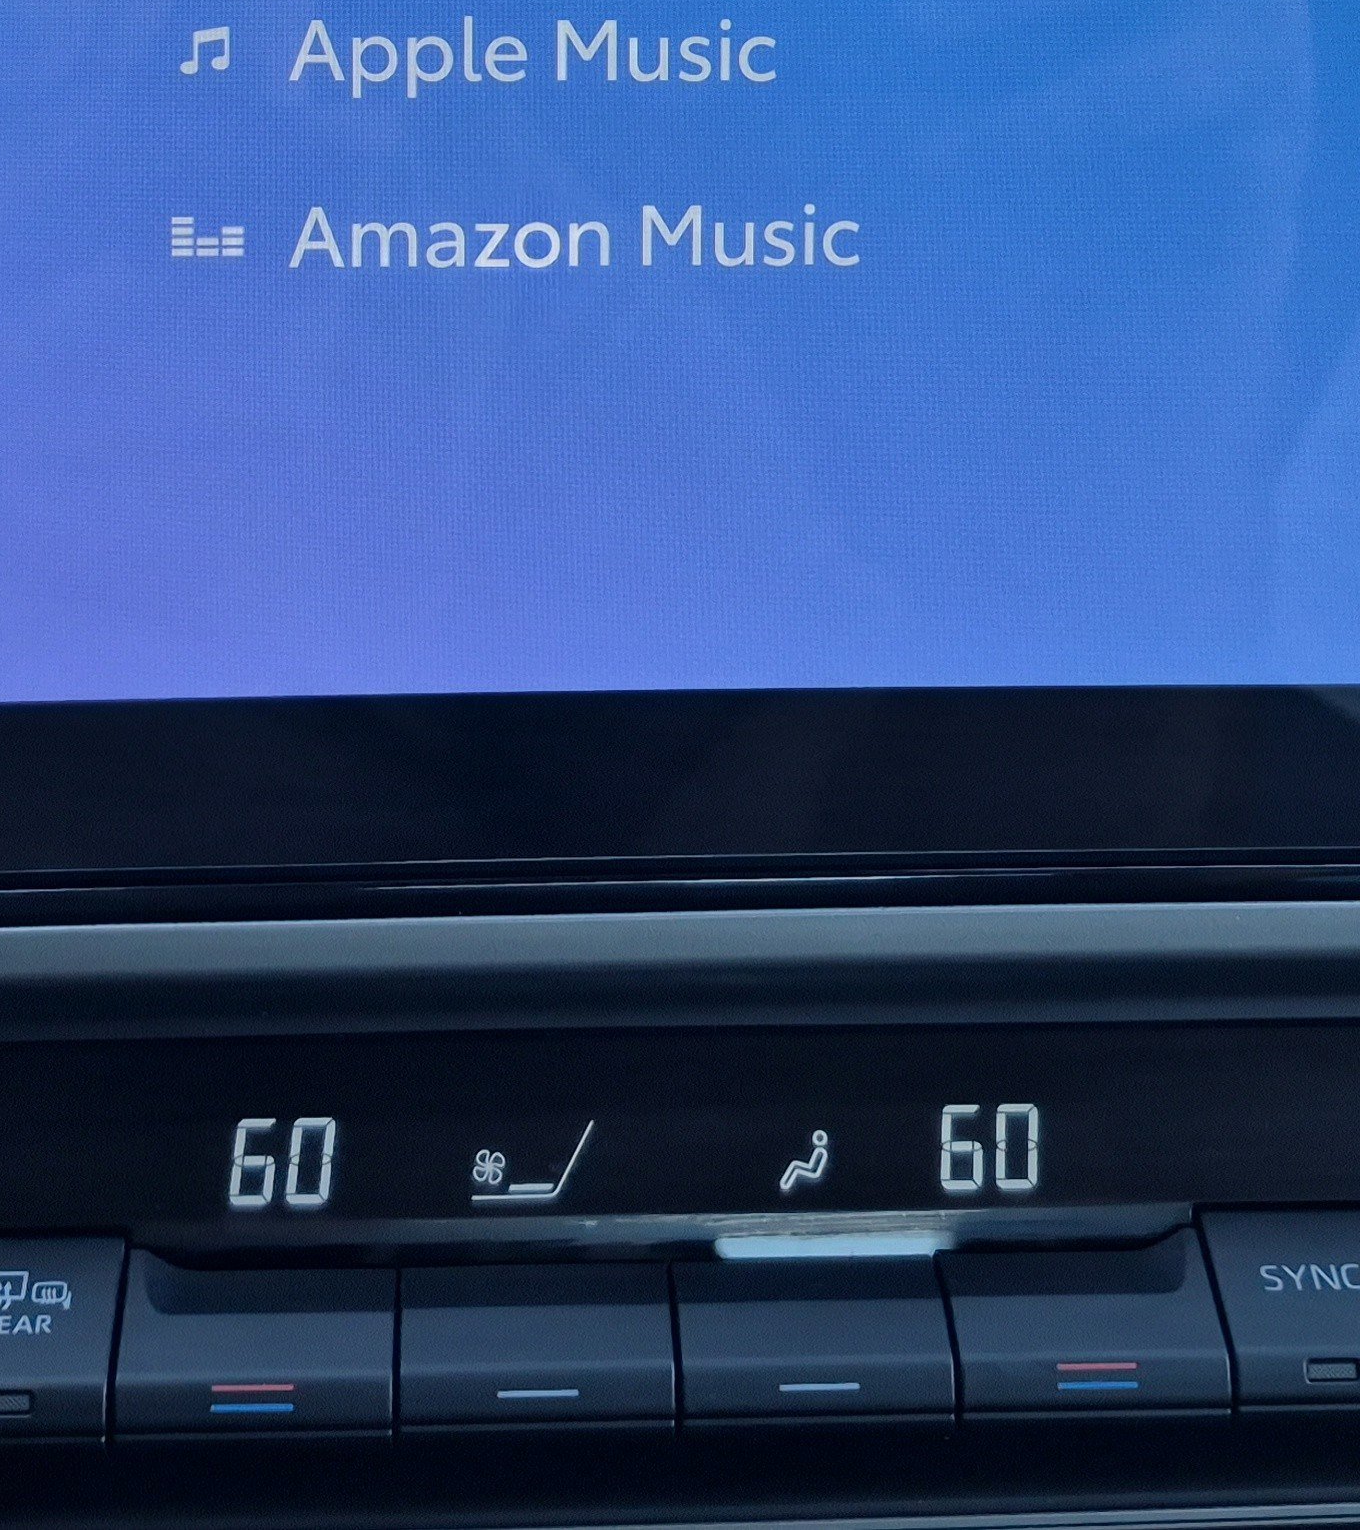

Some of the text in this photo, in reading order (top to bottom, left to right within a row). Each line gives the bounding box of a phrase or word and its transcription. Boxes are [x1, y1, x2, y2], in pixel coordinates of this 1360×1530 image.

[289, 16, 777, 98] Apple Music
[289, 203, 861, 270] Amazon Music
[228, 1117, 337, 1206] 60
[939, 1103, 1039, 1192] 60
